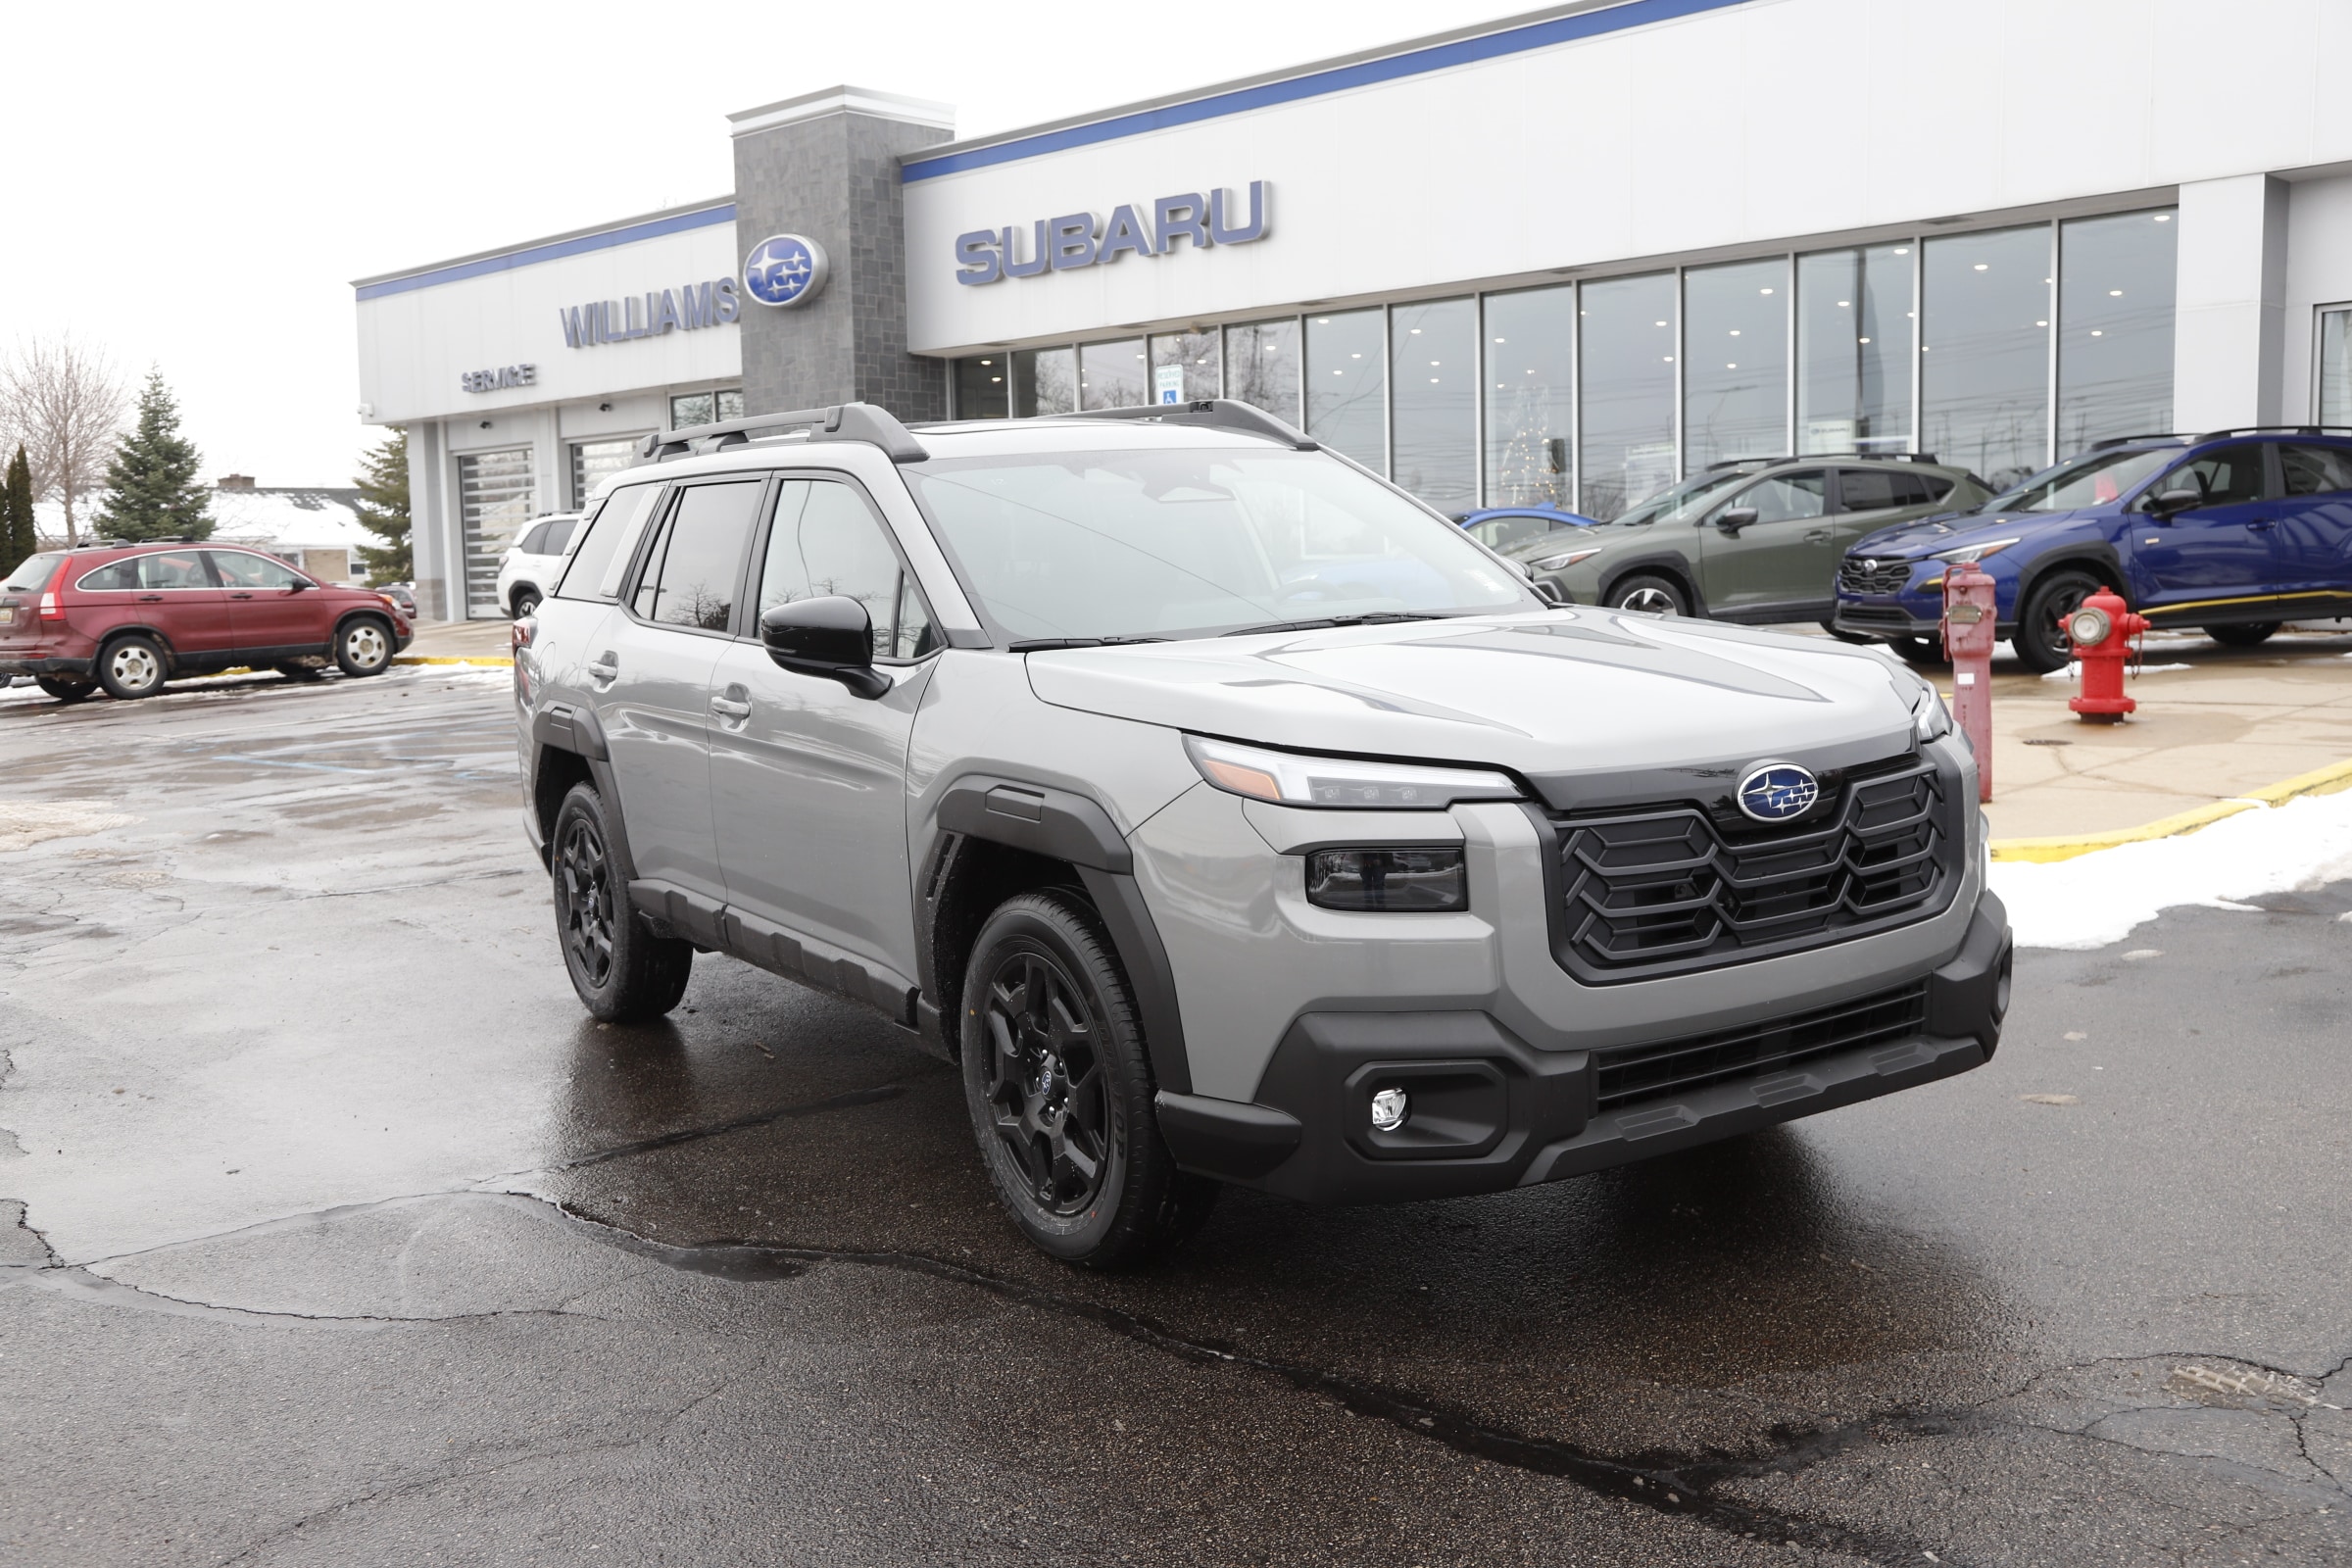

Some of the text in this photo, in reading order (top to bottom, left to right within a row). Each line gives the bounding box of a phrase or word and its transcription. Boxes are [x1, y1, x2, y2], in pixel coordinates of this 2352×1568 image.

[955, 179, 1271, 286] SUBARU
[560, 276, 739, 348] WILLIAMS
[461, 364, 536, 393] SERVICE
